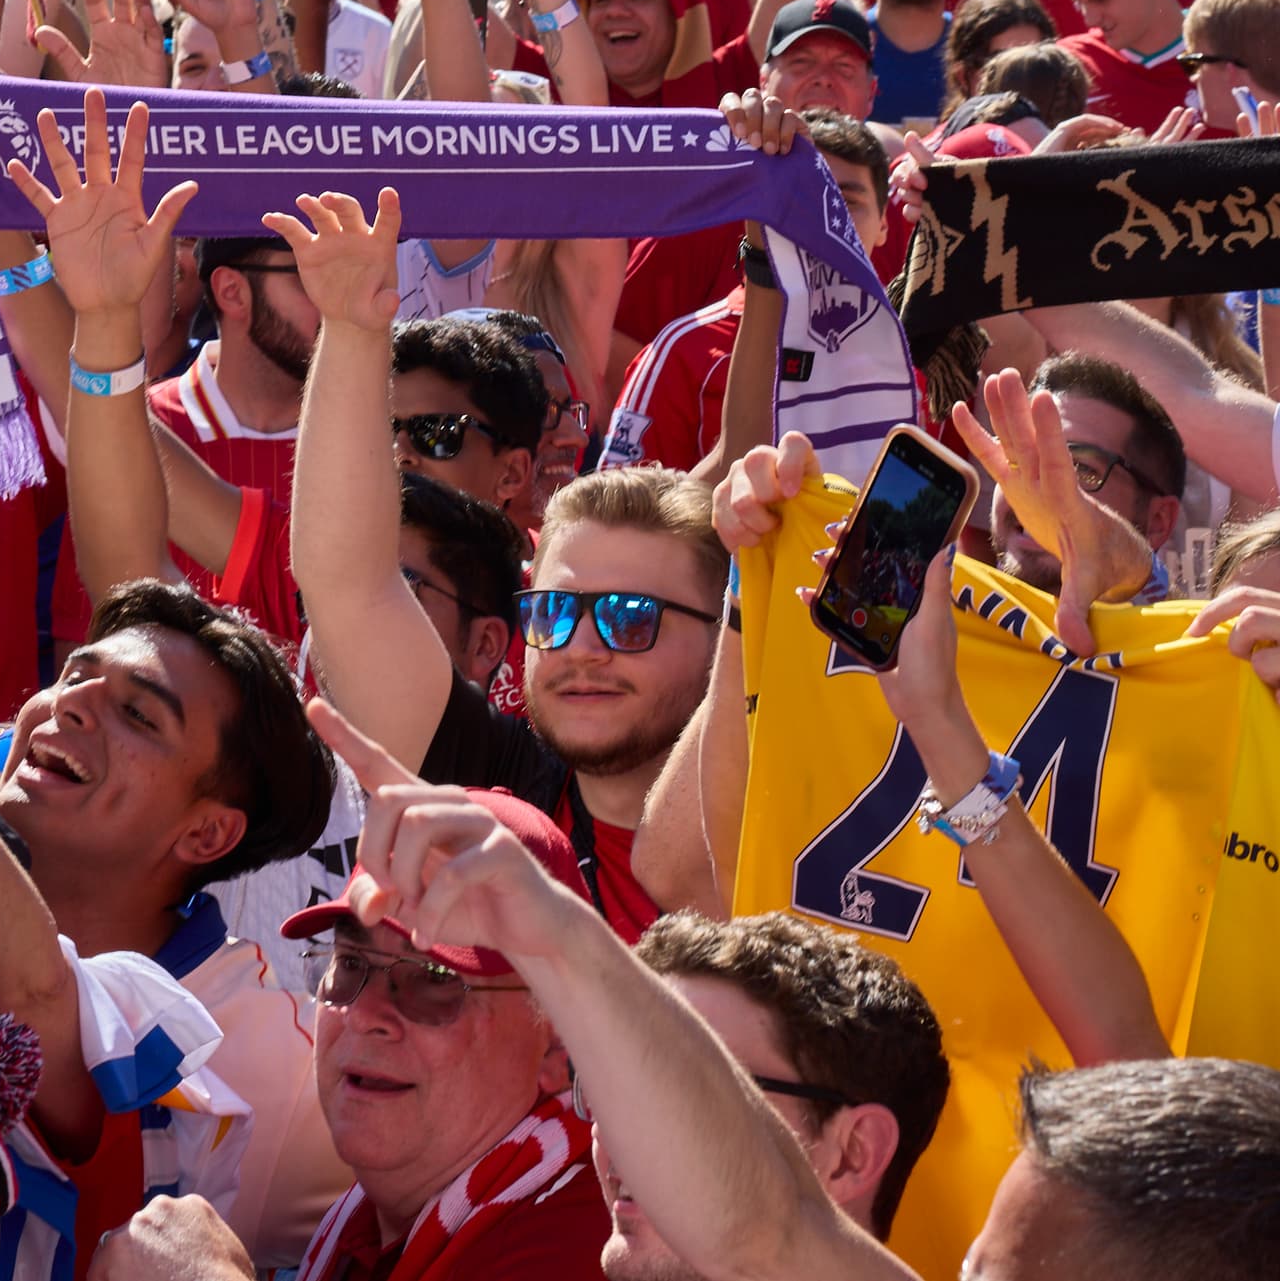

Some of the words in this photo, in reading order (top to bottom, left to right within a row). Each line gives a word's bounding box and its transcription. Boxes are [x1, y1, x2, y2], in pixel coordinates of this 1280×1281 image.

[215, 124, 364, 156] LEAGUE
[371, 123, 580, 156] MORNINGS
[590, 123, 674, 154] LIVE
[792, 640, 1120, 943] 24
[1223, 830, 1280, 874] bro
